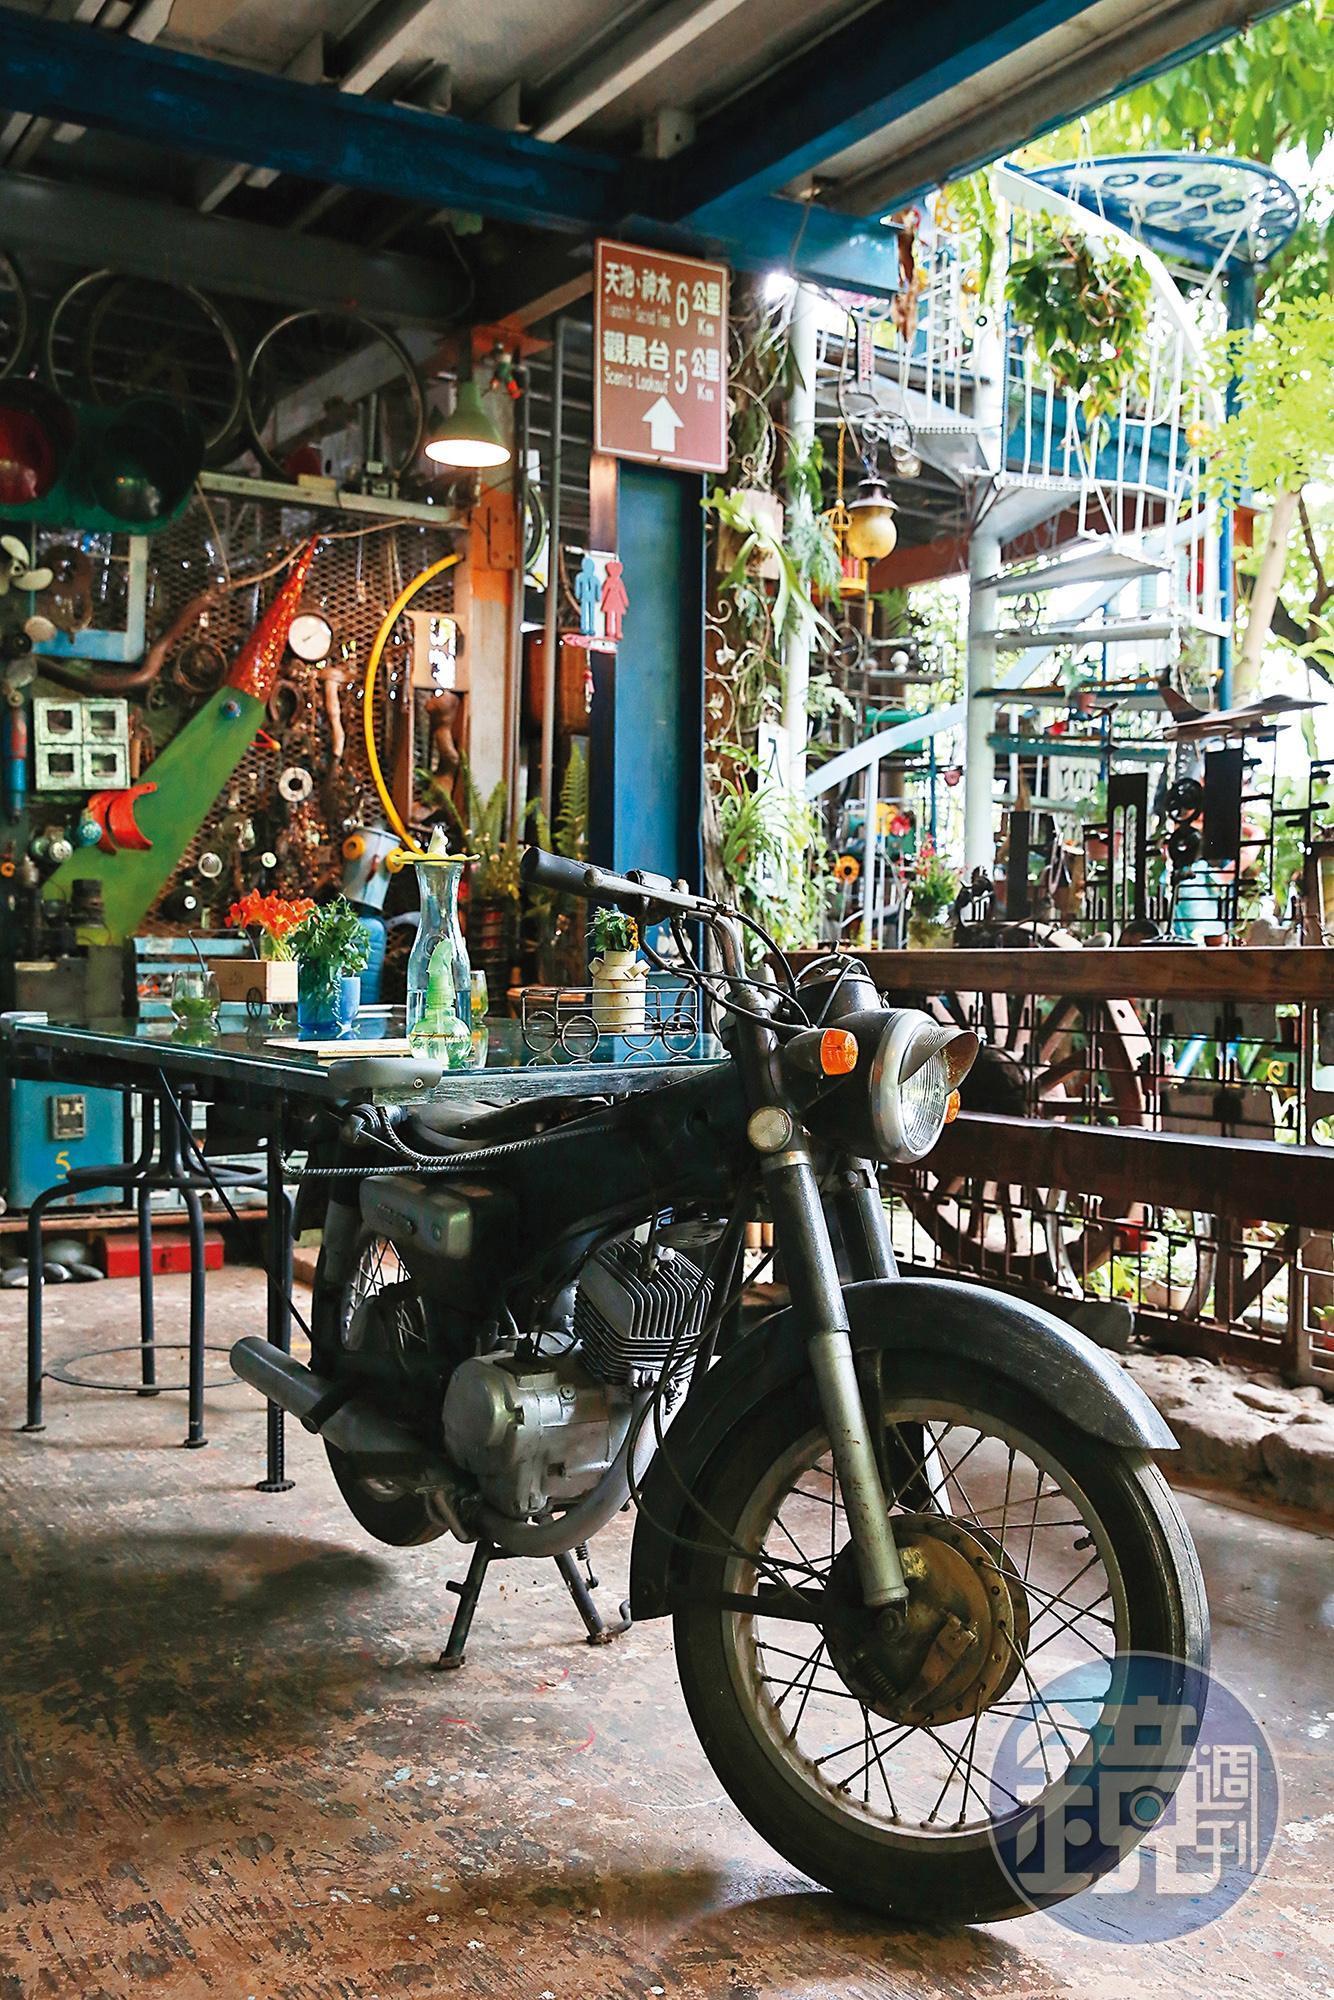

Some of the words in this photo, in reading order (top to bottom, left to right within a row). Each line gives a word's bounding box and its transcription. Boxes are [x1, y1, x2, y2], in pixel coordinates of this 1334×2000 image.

[675, 281, 689, 327] 6
[692, 281, 721, 316] 公里
[603, 330, 670, 371] 觀景台
[675, 348, 688, 395] 5
[691, 347, 720, 382] 公里
